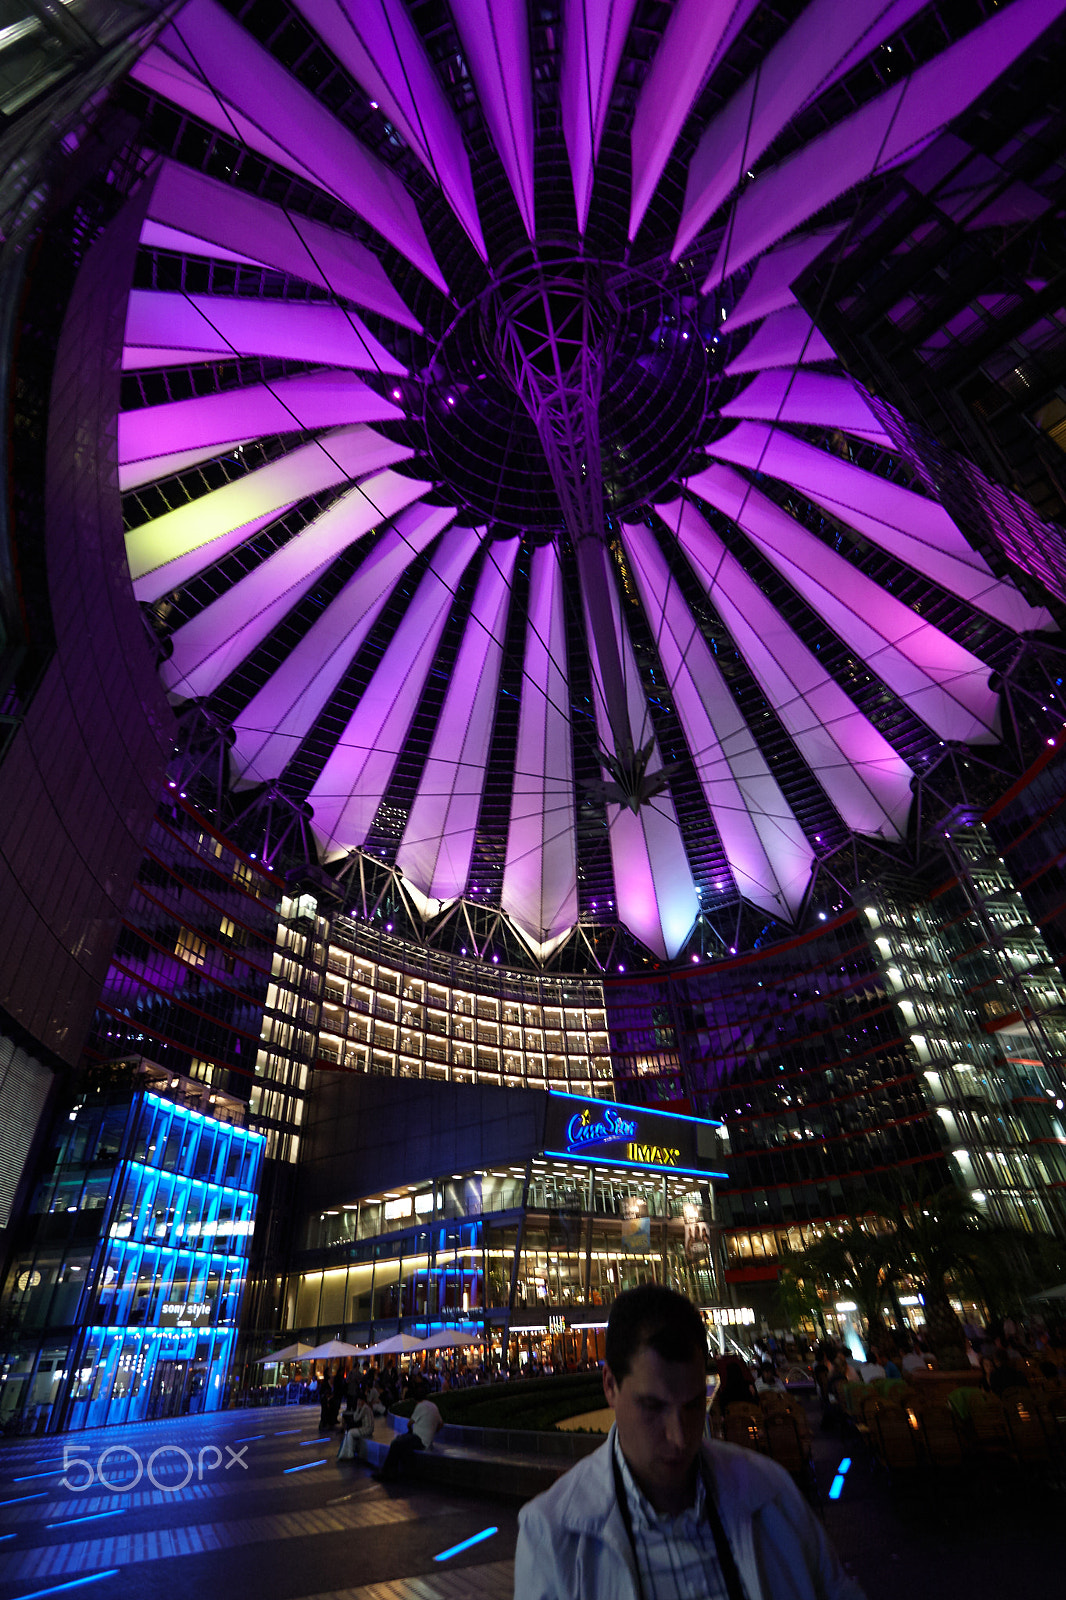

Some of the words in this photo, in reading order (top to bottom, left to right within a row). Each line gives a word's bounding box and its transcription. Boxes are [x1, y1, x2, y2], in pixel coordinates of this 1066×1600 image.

[627, 1142, 678, 1166] IMAX
[161, 1302, 187, 1320] sony
[187, 1302, 211, 1321] style
